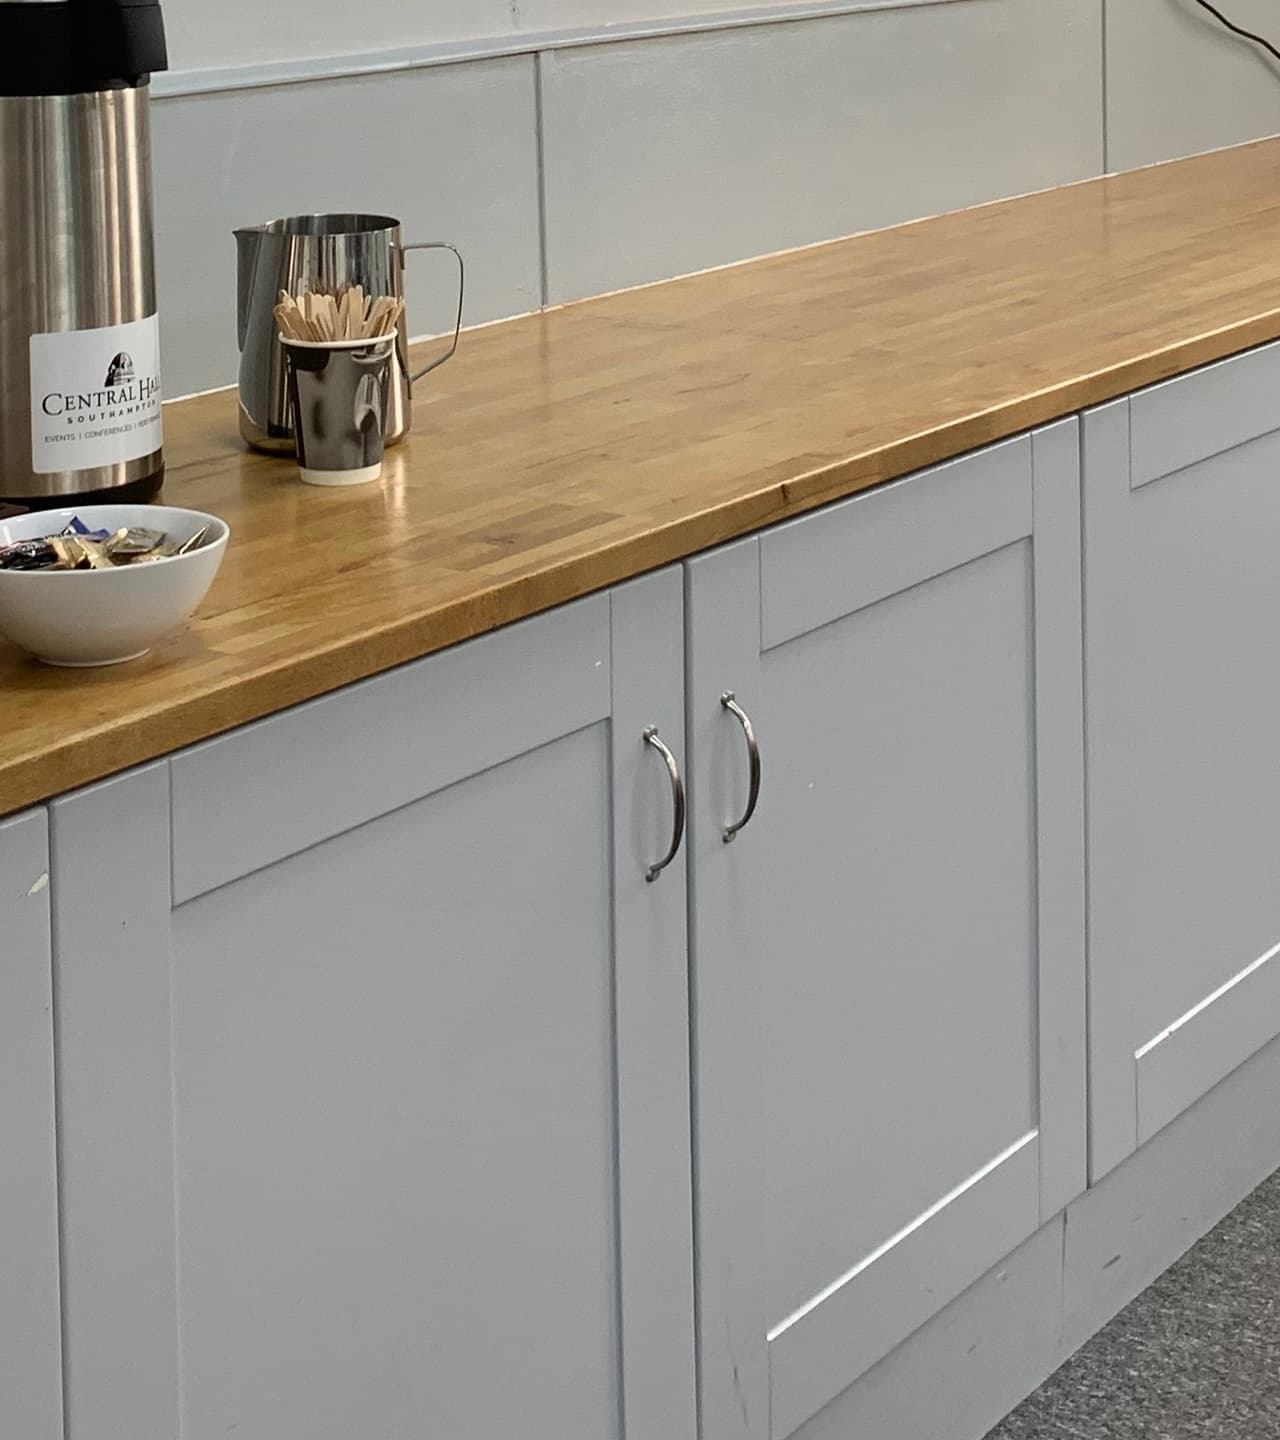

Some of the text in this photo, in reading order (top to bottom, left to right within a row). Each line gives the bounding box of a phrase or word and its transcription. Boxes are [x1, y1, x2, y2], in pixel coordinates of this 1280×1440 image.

[41, 386, 136, 416] CENTRAL
[66, 399, 156, 425] SOUTHAMPTON
[44, 432, 76, 443] EVENTS
